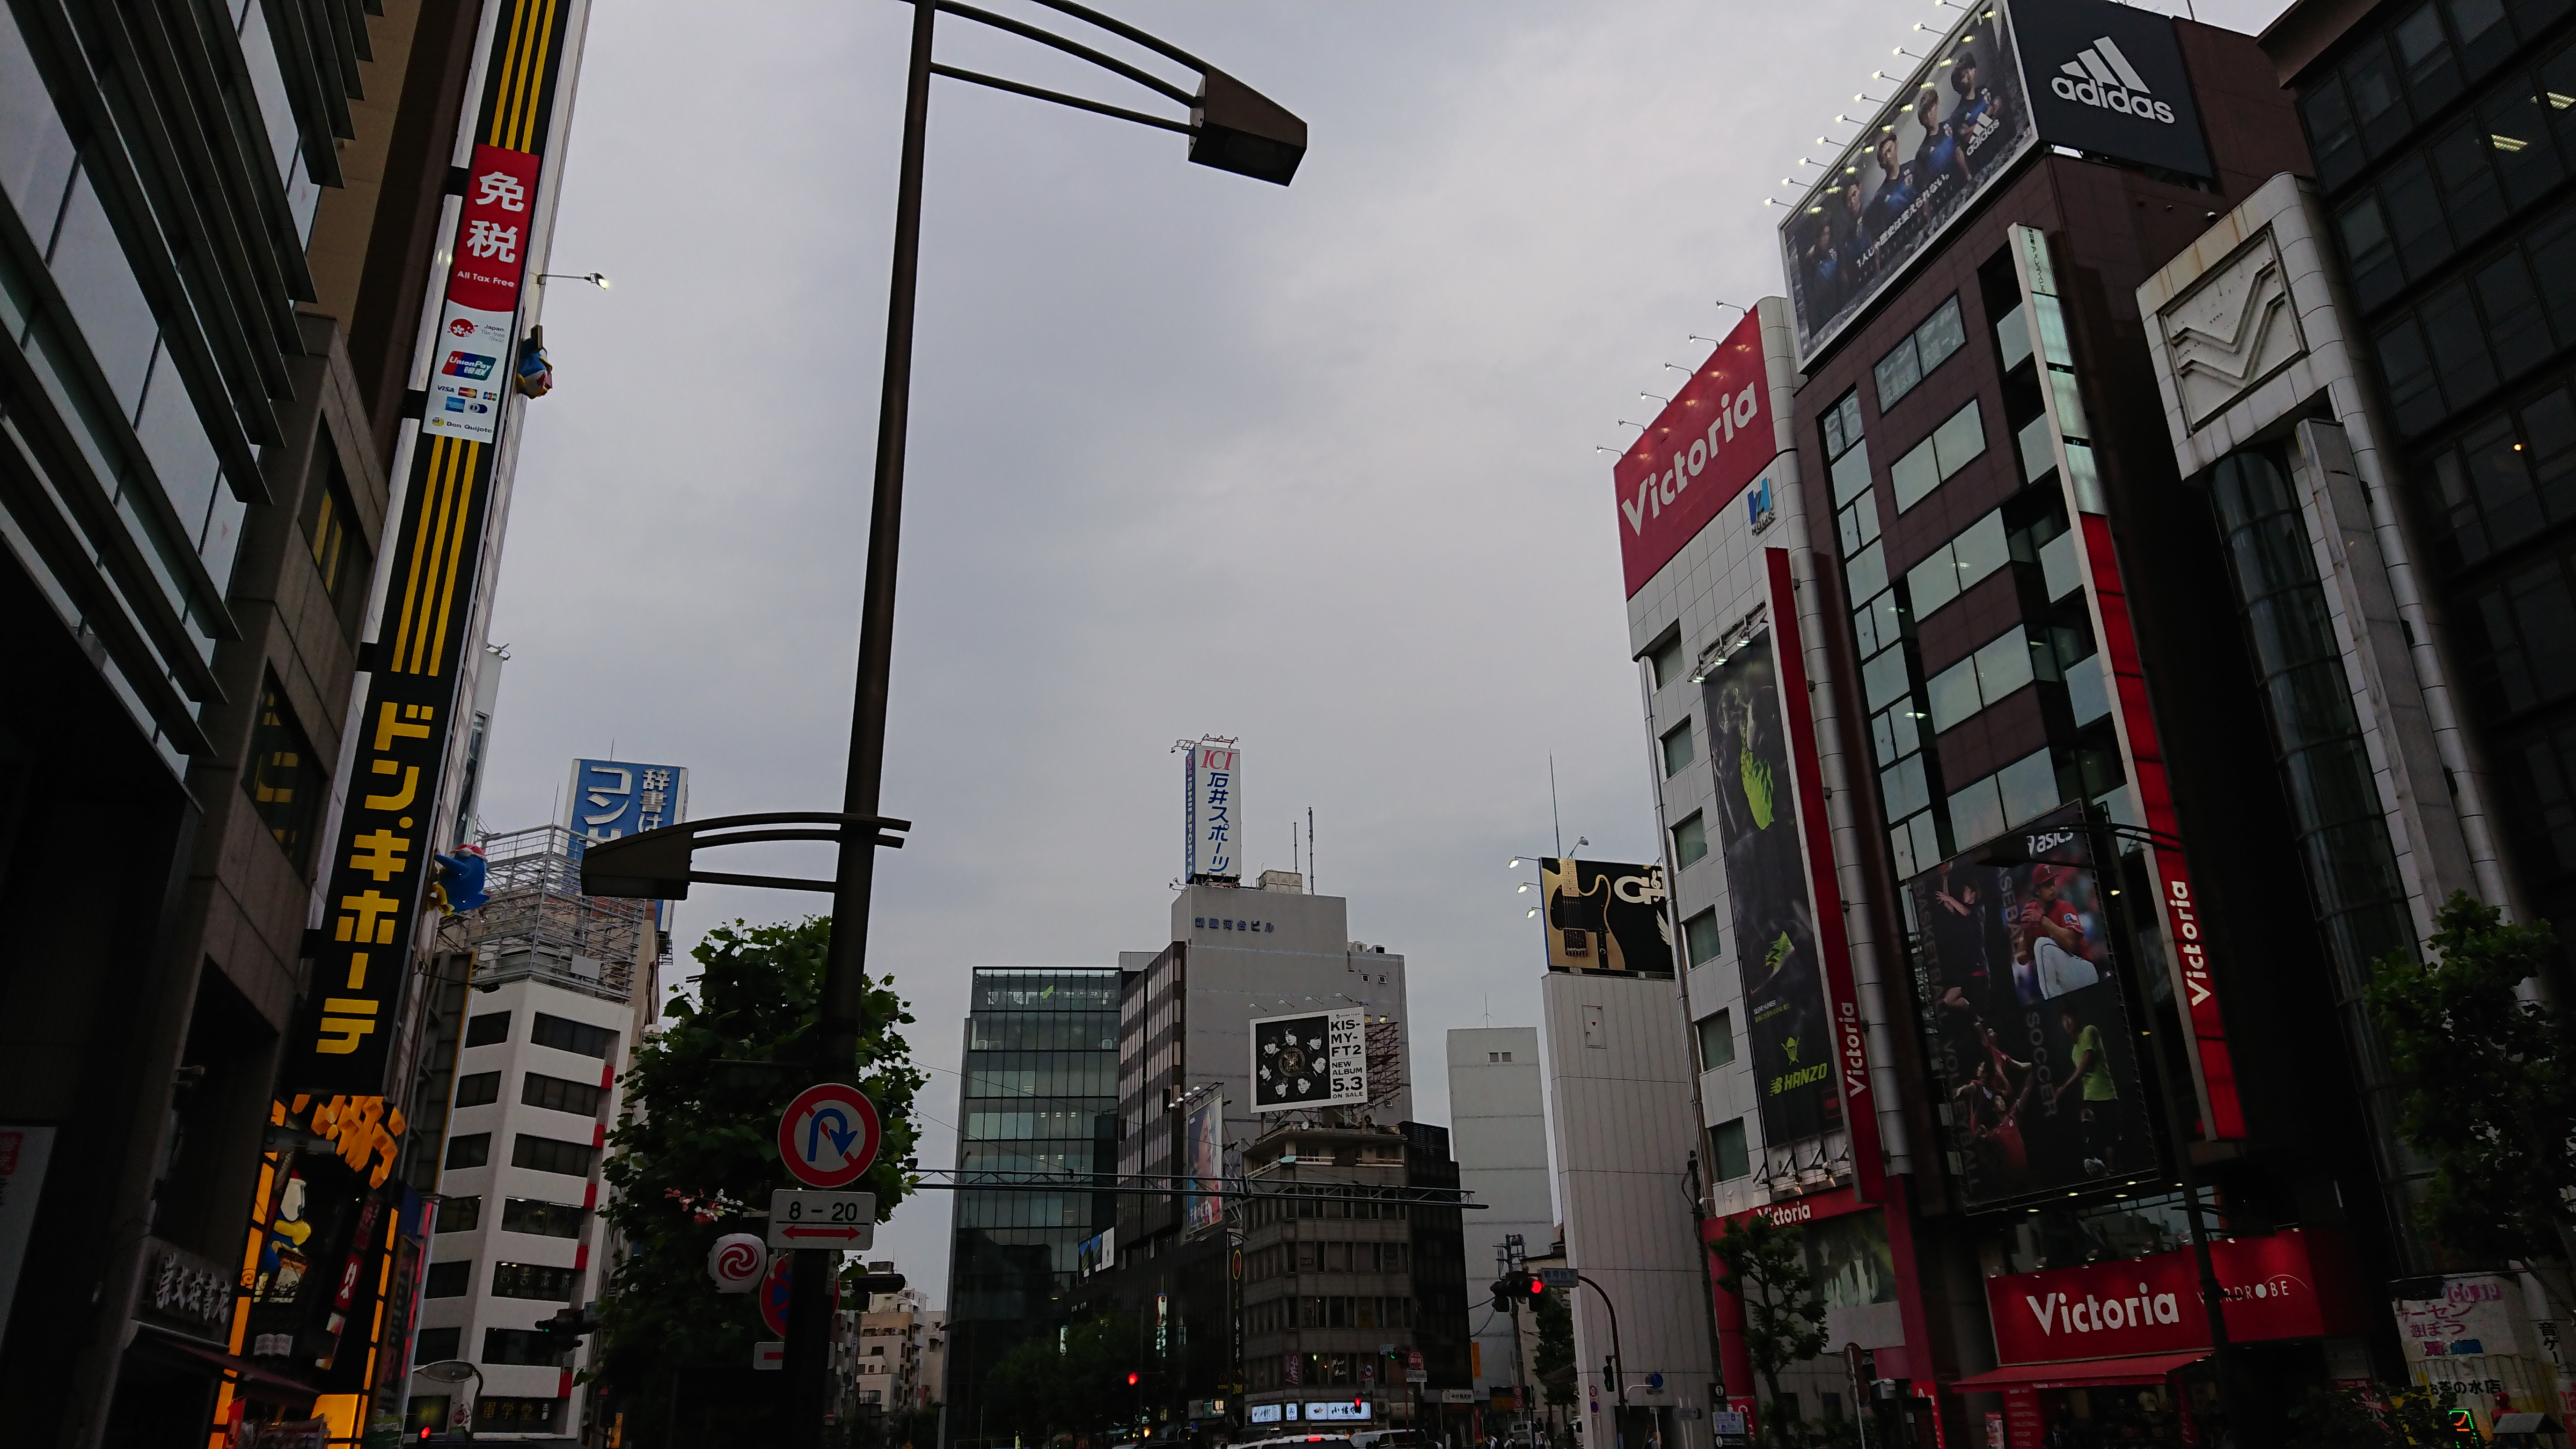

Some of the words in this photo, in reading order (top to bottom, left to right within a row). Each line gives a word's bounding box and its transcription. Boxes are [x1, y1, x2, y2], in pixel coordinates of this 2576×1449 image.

[2051, 76, 2175, 125] adidas
[1967, 119, 2000, 156] adidas
[466, 171, 525, 263] 免税
[473, 273, 490, 283] Tax
[493, 277, 514, 287] Free
[449, 356, 492, 372] UnionPay
[464, 424, 492, 433] Quijote
[1621, 381, 1757, 537] Victoria
[1200, 749, 1238, 770] ICI
[638, 768, 670, 833] 辞書は
[1207, 772, 1229, 872] 石井スポーツ
[2037, 827, 2074, 853] asics
[2044, 865, 2050, 874] T
[1998, 867, 2027, 961] ASEBALL
[1915, 881, 1948, 1025] BASKETBALL
[2169, 881, 2211, 1007] Victoria
[1331, 1020, 1360, 1031] KIS-
[1331, 1032, 1358, 1044] MY-
[1332, 1045, 1361, 1057] FT2
[1838, 1002, 1867, 1098] Victoria
[1784, 1062, 1828, 1091] HANZO
[2027, 1011, 2058, 1117] SOCCER
[1332, 1076, 1363, 1092] 5.3
[1943, 1039, 1980, 1193] VOLEYBALL
[789, 1201, 801, 1220] 8
[831, 1202, 857, 1222] 20
[1756, 1200, 1811, 1226] Victoria
[2197, 1281, 2289, 1305] RDROBE
[2027, 1282, 2180, 1337] Victoria
[2430, 1379, 2501, 1395] お茶の水店
[1332, 1405, 1361, 1415] 小諸そ
